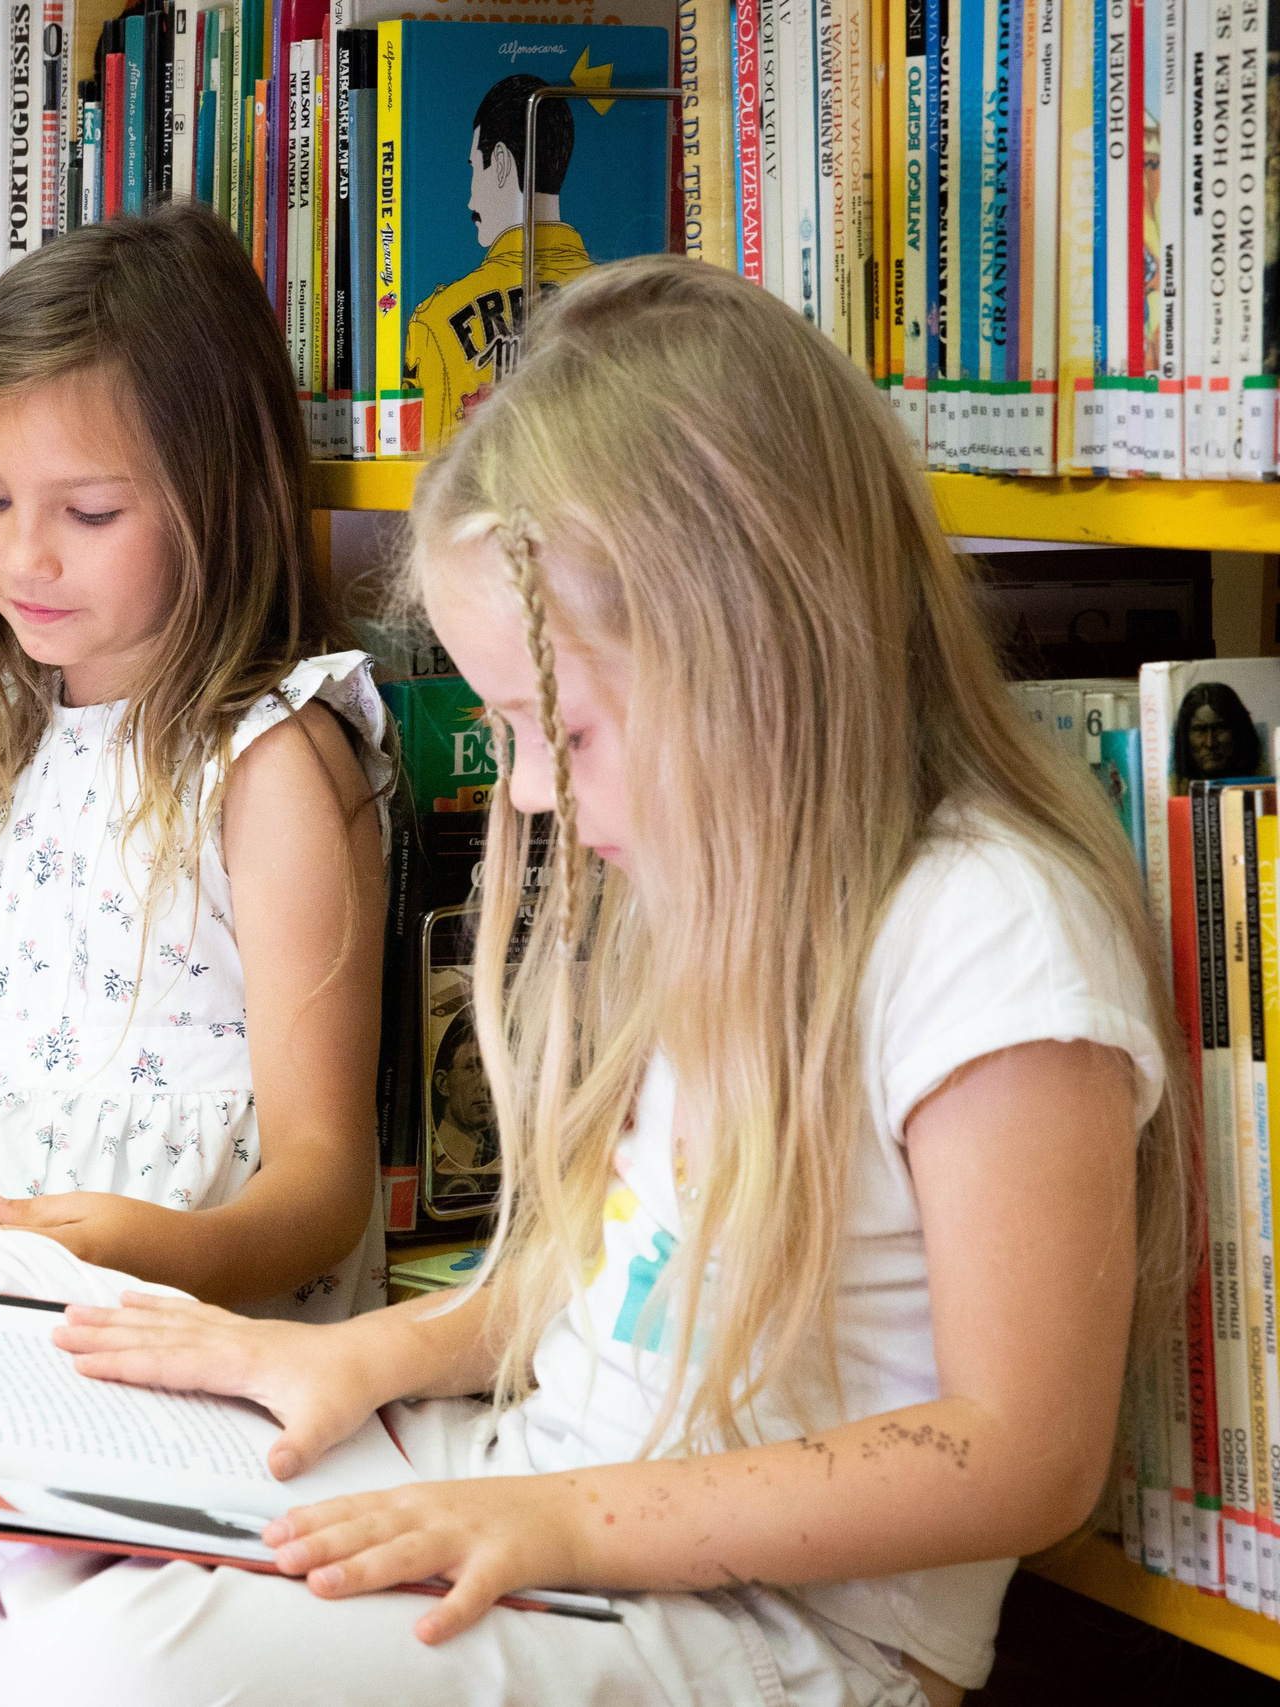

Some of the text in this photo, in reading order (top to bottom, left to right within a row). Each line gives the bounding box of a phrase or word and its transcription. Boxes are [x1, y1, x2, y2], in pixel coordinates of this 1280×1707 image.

[499, 40, 568, 63] alfonsocaras
[821, 27, 833, 82] DATAS
[1215, 5, 1231, 39] SE
[163, 62, 173, 102] Frida
[739, 82, 758, 140] QUE
[764, 60, 775, 102] DOS
[849, 12, 862, 193] ROMA ANTIGA
[926, 51, 938, 139] INCRÍVEL
[1040, 44, 1052, 106] Grandes
[1108, 32, 1125, 159] O HOMEM
[1211, 54, 1230, 166] HOMEM
[1239, 47, 1258, 161] HOMEM
[10, 4, 31, 251] PORTUGUESES
[58, 33, 69, 235] JOHANN GUTENBERG
[163, 108, 173, 156] Kahlo.
[289, 74, 297, 210] NELSON MANDELA
[300, 71, 310, 208] NELSON MANDELA
[339, 50, 350, 199] MARGARET MEAD
[682, 117, 700, 155] DE
[764, 108, 776, 157] VIDA
[821, 90, 834, 177] GRANDES
[831, 15, 845, 250] EUROPA MEDIEVAL
[907, 66, 922, 251] ANTIGO EGIPTO
[1193, 51, 1203, 216] SARAH HOWARTH
[380, 140, 396, 287] FREDDIE Mercury
[740, 147, 759, 254] FIZERAM
[765, 163, 777, 180] A
[1211, 178, 1226, 198] O
[1239, 174, 1255, 194] O
[894, 259, 904, 326] PASTEUR
[981, 202, 997, 343] GRANDES
[994, 205, 1009, 346] GRANDES
[1210, 210, 1227, 297] COMO
[1238, 205, 1255, 293] COMO
[298, 280, 307, 387] Benjamin Pogrund
[1164, 244, 1177, 356] EDITORIAL ESTAMPA
[1211, 302, 1224, 345] Segal
[1239, 299, 1252, 342] Segal
[1086, 708, 1102, 738] 6
[396, 831, 410, 936] OS IRMÃOS WRIGHT
[1213, 1242, 1227, 1341] STRUAN REID
[1226, 1242, 1240, 1341] STRUAN REID
[1261, 1256, 1276, 1355] STRUAN REID
[1222, 1429, 1234, 1503] UNESCO
[1235, 1429, 1248, 1503] UNESCO
[1258, 1488, 1269, 1508] OS
